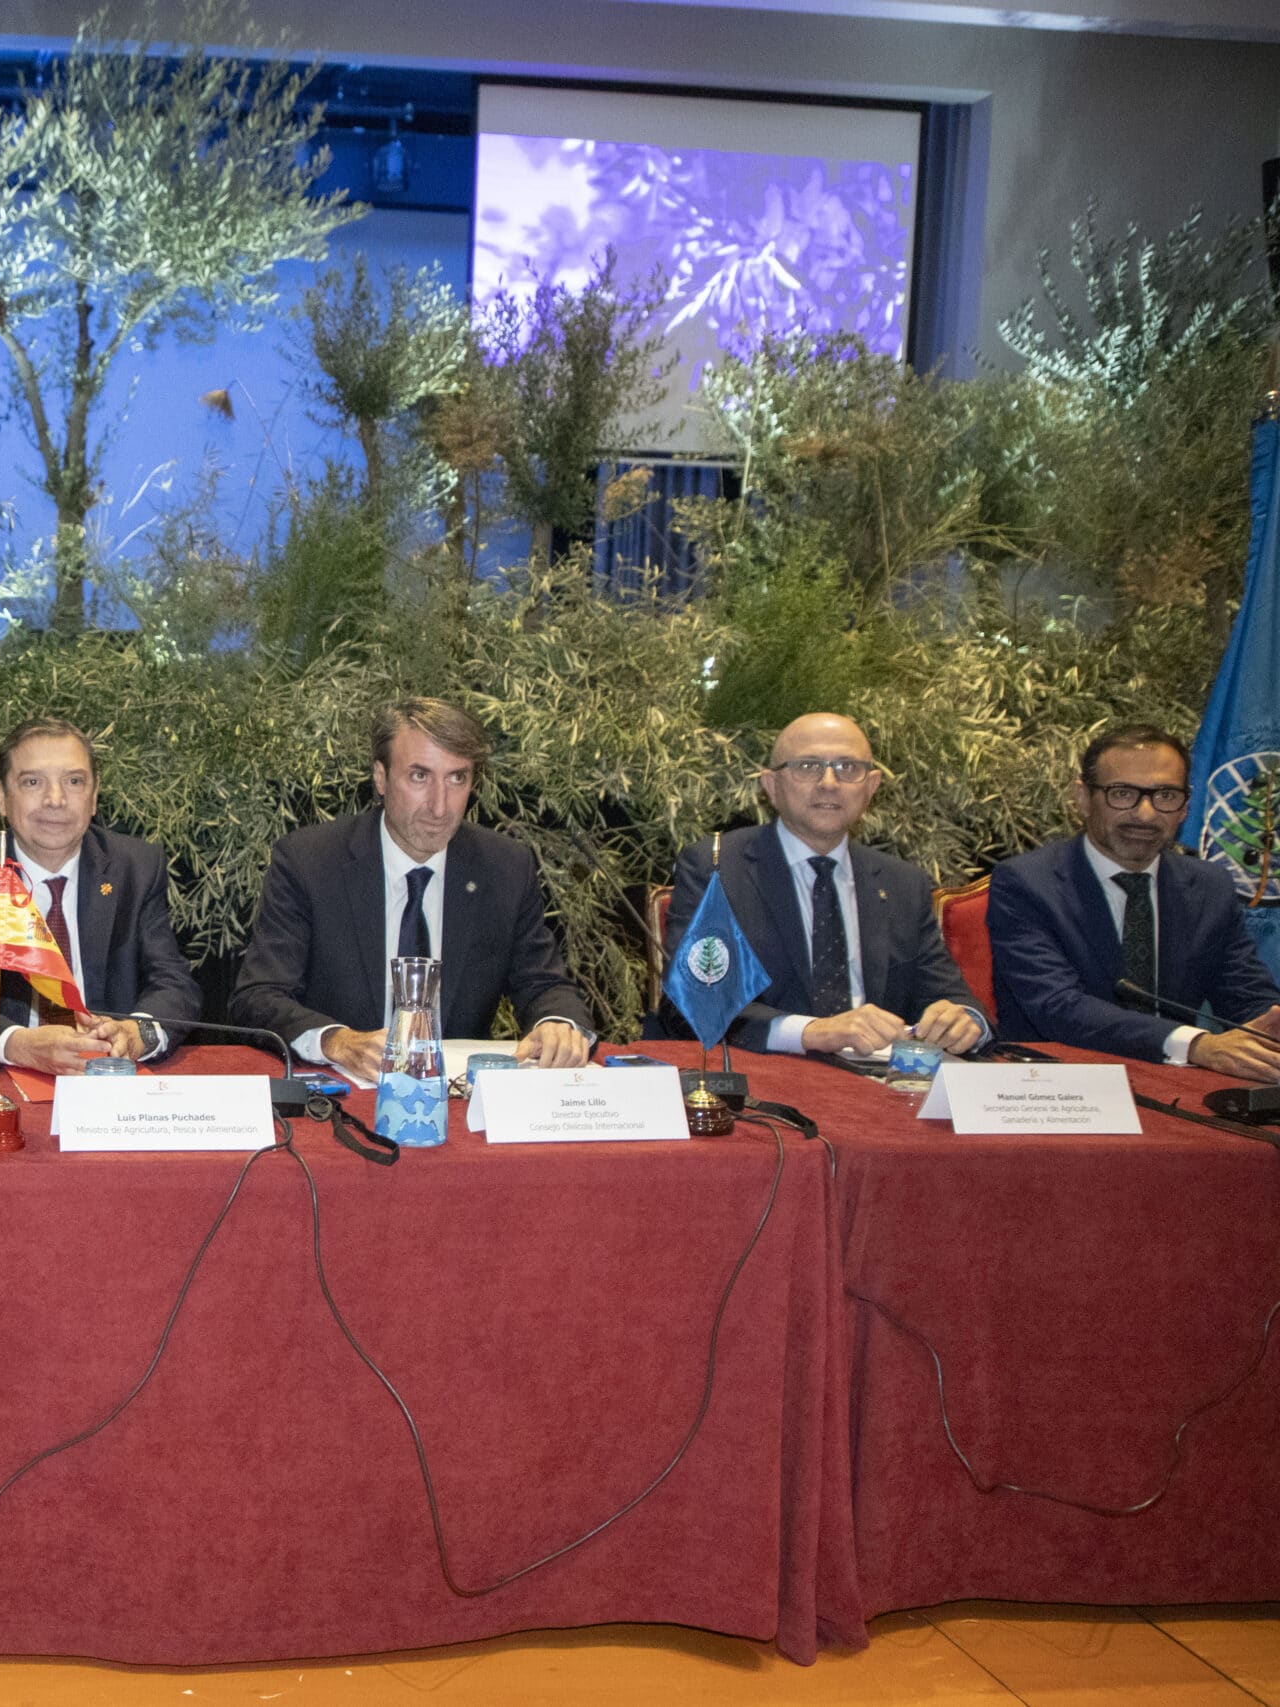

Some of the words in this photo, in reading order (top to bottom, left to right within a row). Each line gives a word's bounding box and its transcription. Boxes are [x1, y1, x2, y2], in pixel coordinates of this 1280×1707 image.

[688, 1080, 735, 1092] BSCH
[997, 1093, 1027, 1101] Manuel
[560, 1099, 586, 1107] Jaime
[588, 1098, 607, 1107] Lillo
[117, 1113, 136, 1122] Luis
[138, 1113, 169, 1122] Planas
[171, 1113, 216, 1122] Puchades
[551, 1110, 582, 1119] Director
[584, 1110, 620, 1120] Ejecutivo
[76, 1125, 108, 1134] Ministro
[111, 1126, 121, 1134] de
[124, 1125, 170, 1136] Agricultura,
[173, 1125, 196, 1134] Pesca
